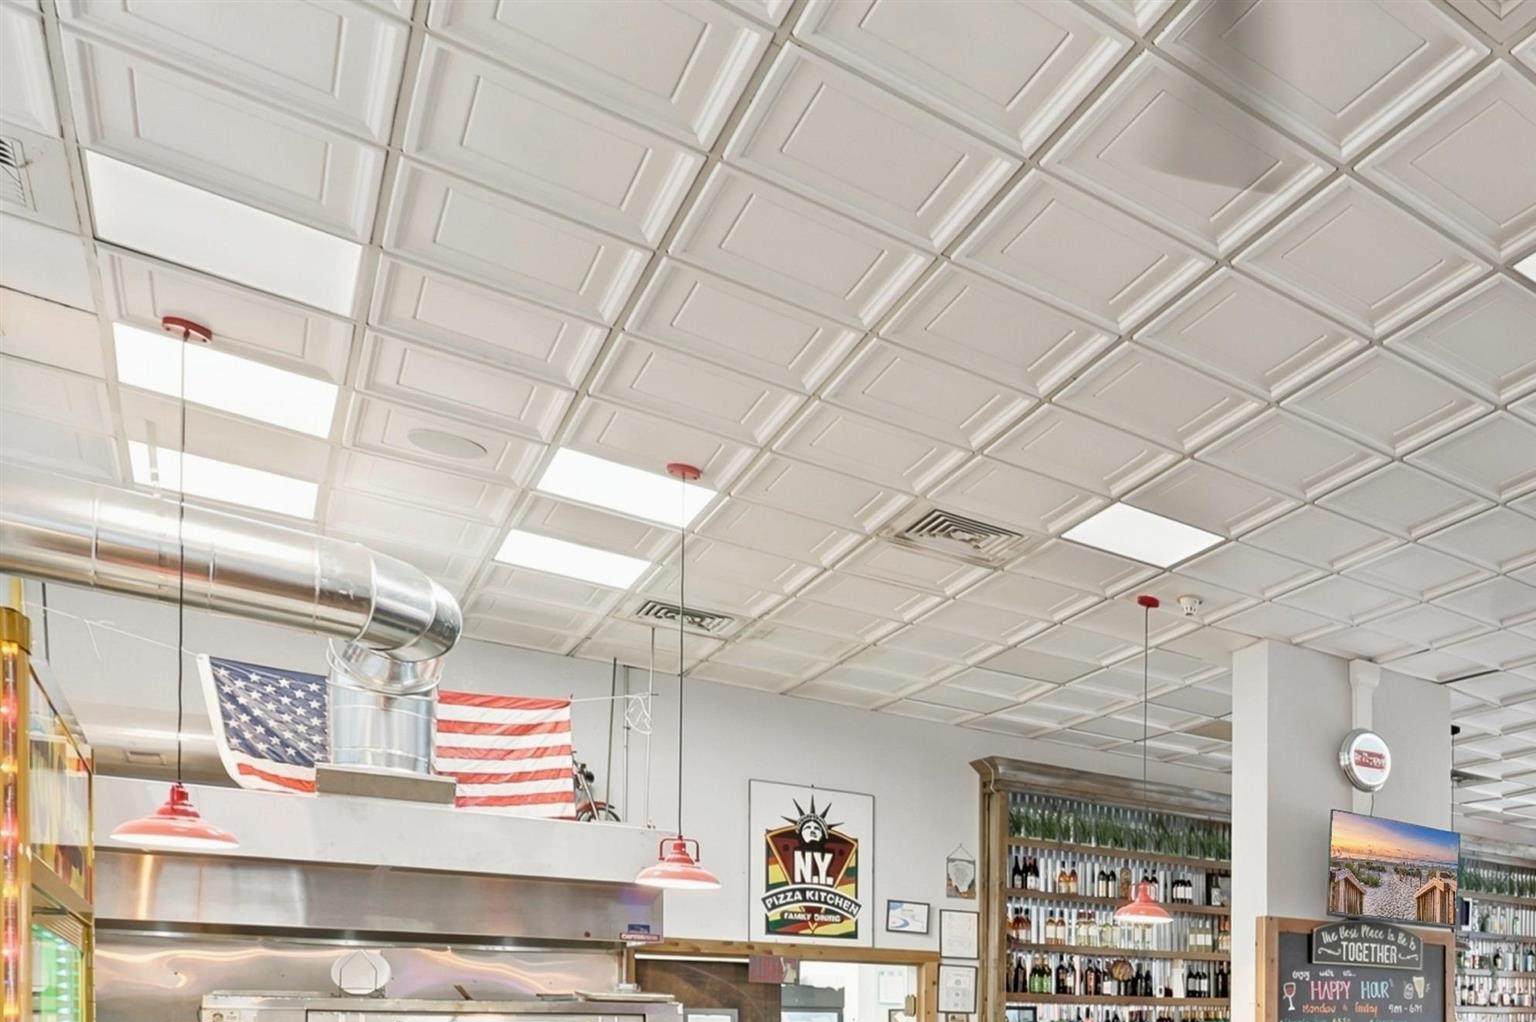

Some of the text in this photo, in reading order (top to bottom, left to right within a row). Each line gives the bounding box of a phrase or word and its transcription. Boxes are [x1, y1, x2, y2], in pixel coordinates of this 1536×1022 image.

[794, 850, 834, 885] N.Y.
[765, 890, 859, 915] PIZZA KITCHEN
[783, 912, 812, 920] FAMILY
[1321, 930, 1338, 944] The
[1338, 925, 1359, 940] Best
[1361, 924, 1385, 939] Place
[1341, 941, 1397, 964] TOGETHER
[1310, 980, 1351, 1000] HAPPY
[1302, 1003, 1336, 1014] Monday
